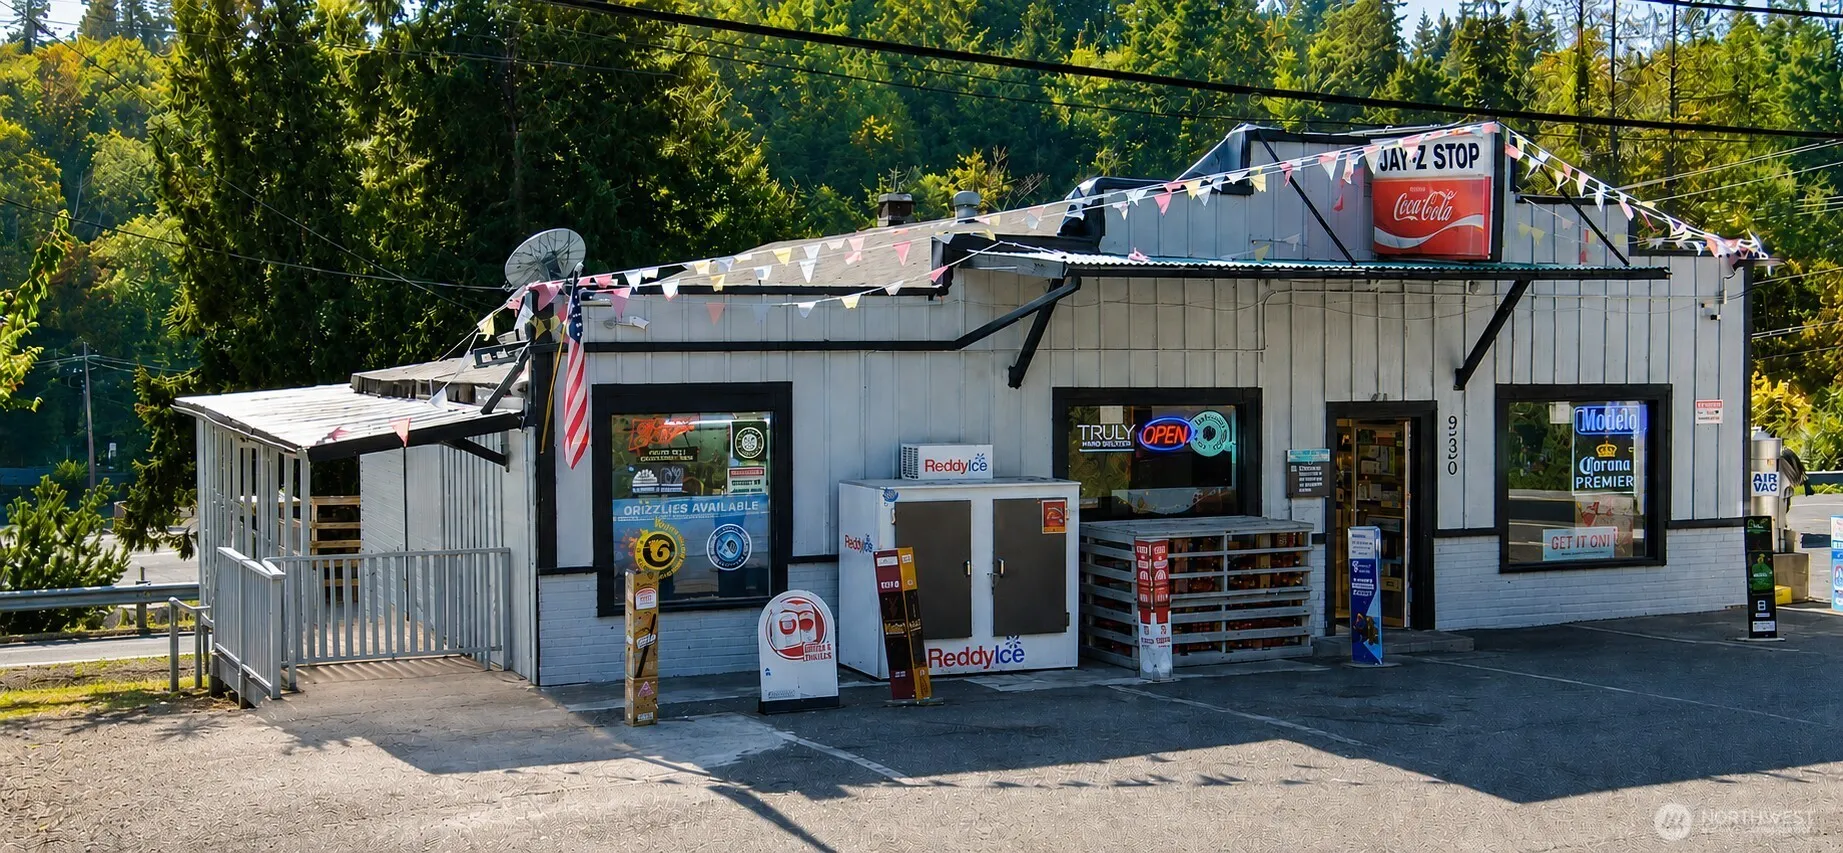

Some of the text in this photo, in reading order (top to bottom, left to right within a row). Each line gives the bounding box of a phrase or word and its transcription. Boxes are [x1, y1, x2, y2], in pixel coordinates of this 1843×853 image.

[1433, 143, 1480, 170] STOP
[1577, 408, 1637, 431] Modelo
[1077, 424, 1136, 440] TRULY
[1143, 424, 1190, 444] OPEN
[1575, 475, 1634, 489] PREMIER
[1753, 474, 1777, 482] AIR
[1753, 482, 1777, 492] VAC
[692, 500, 759, 513] AVAILABLE
[1551, 536, 1573, 549] GET
[1576, 536, 1587, 548] IT
